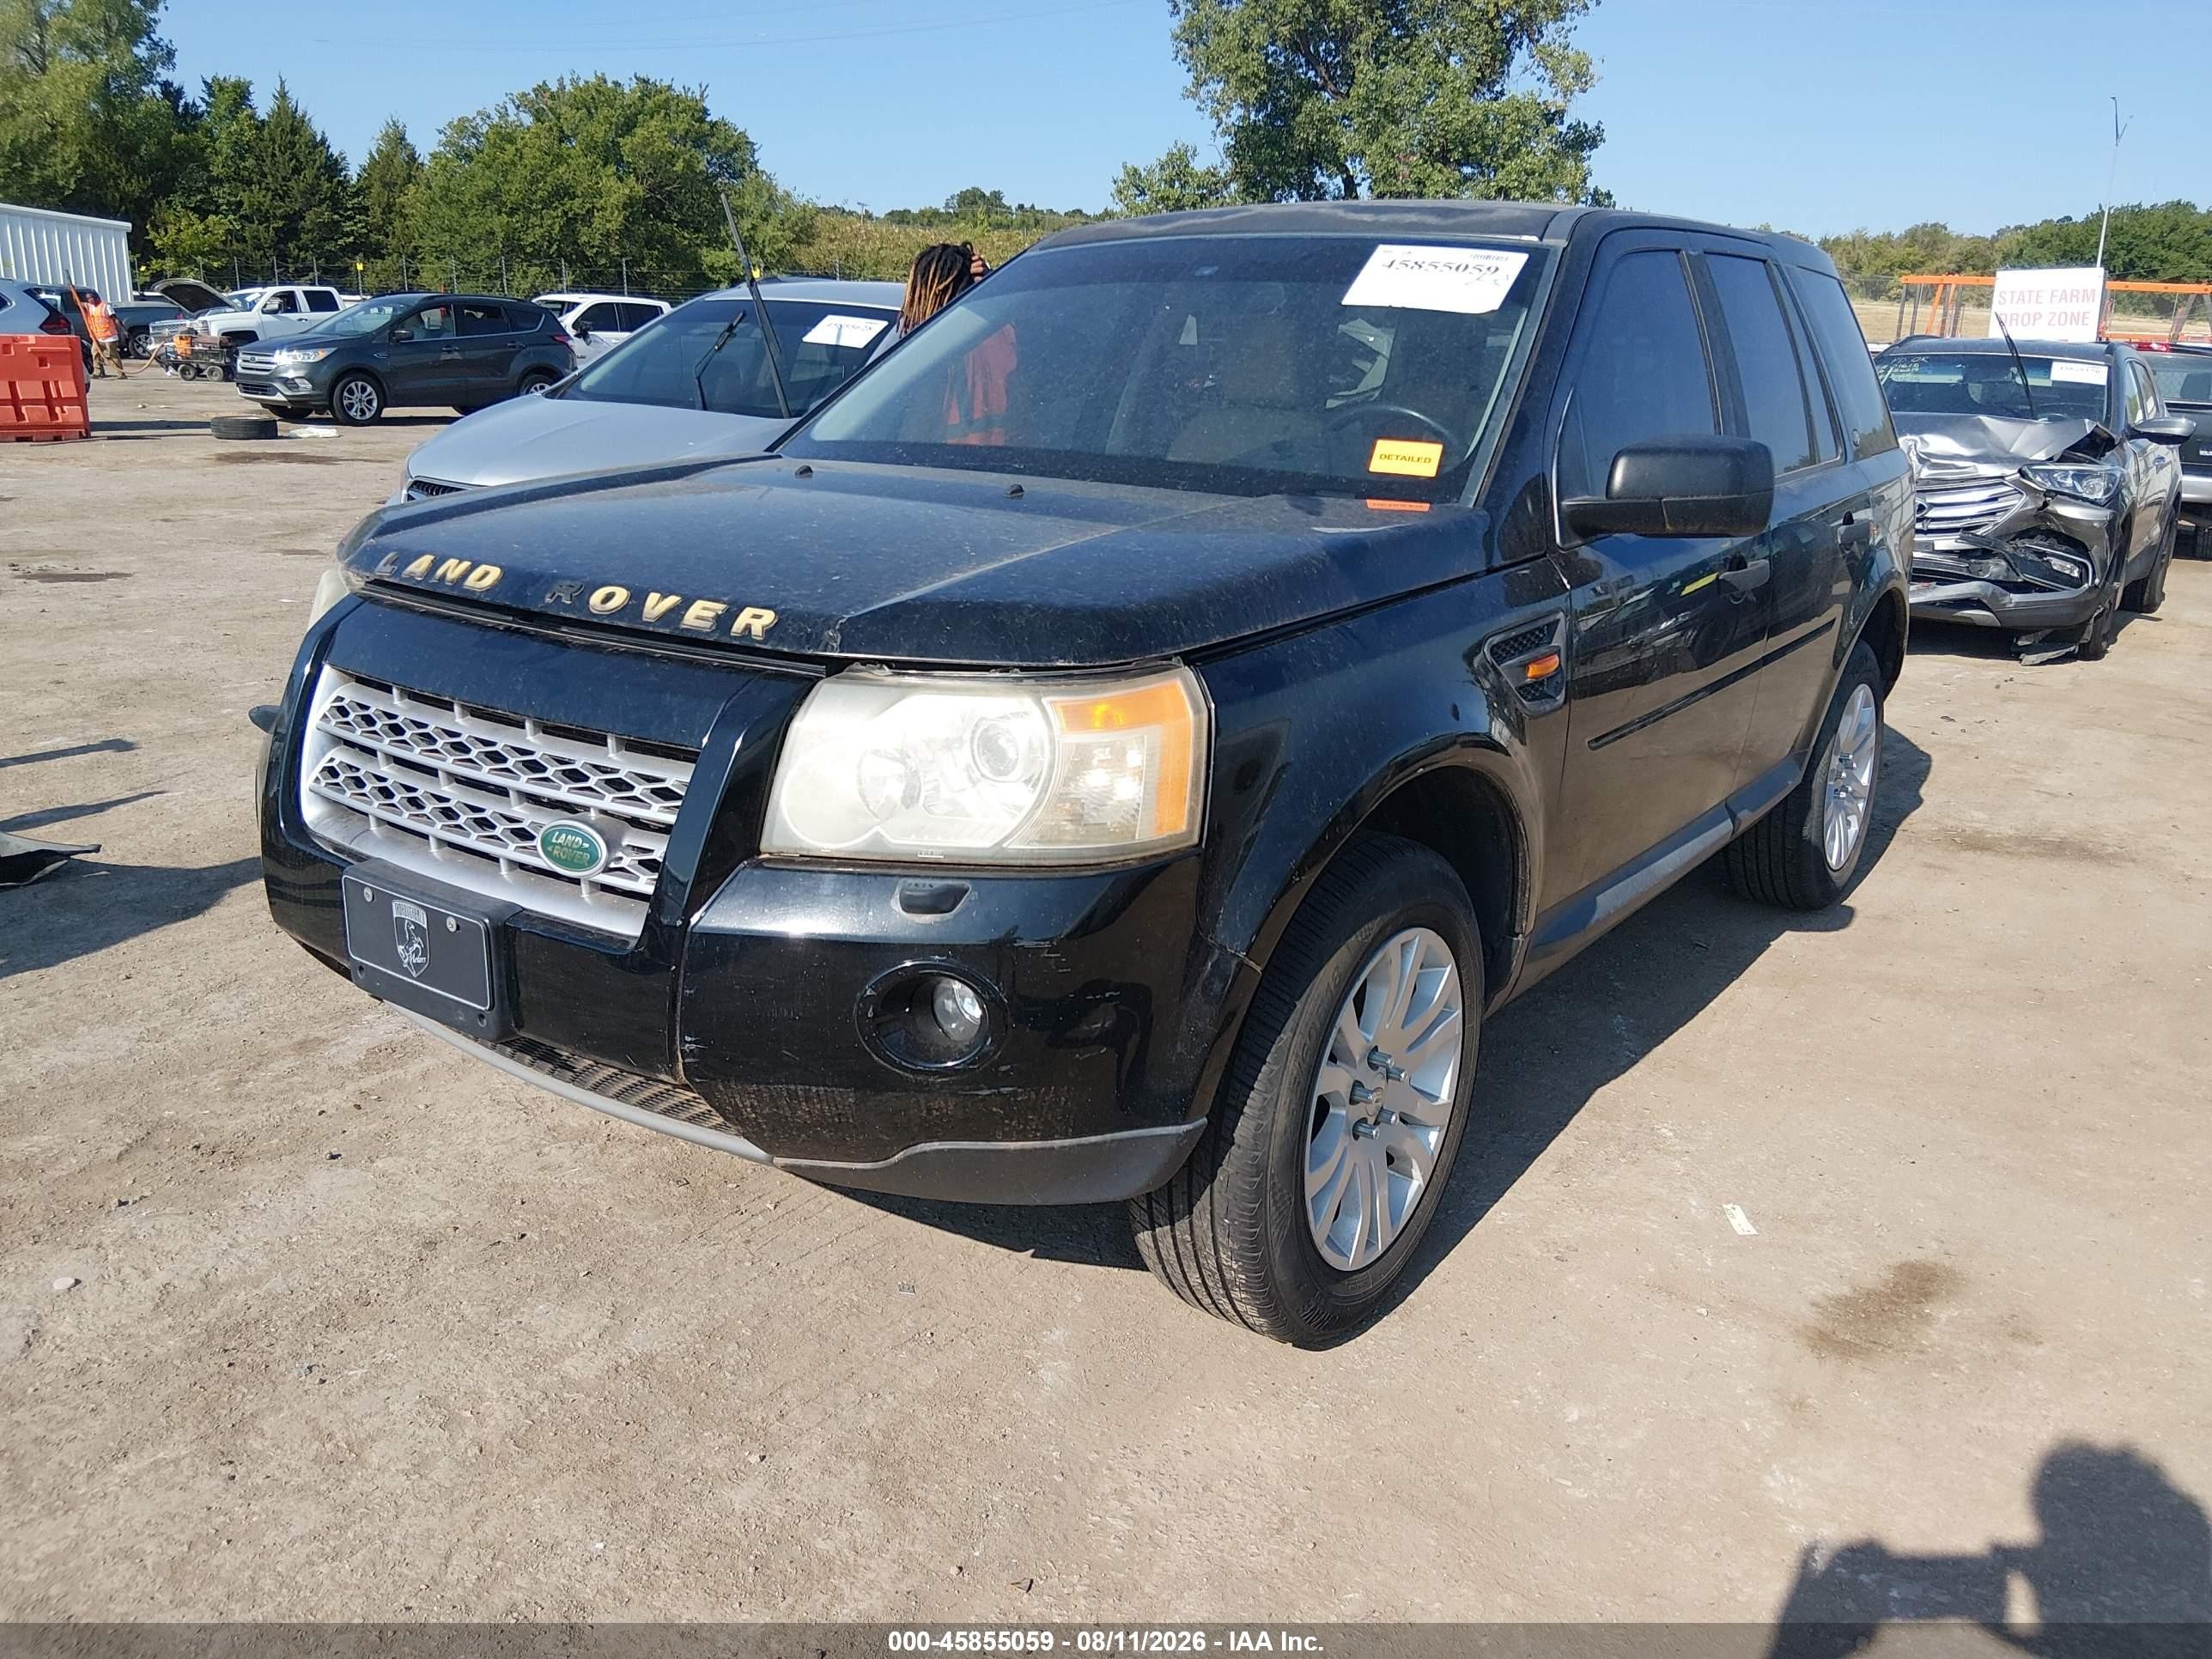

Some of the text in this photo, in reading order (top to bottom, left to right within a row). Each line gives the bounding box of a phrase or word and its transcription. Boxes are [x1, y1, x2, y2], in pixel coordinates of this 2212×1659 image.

[1382, 259, 1499, 275] 45855059
[1998, 289, 2096, 306] STATE FARM
[2047, 311, 2090, 326] ZONE
[1379, 453, 1431, 464] DETAILED
[374, 551, 779, 641] LAND ROVER
[551, 831, 583, 848] LAND
[553, 846, 591, 866] ROVER
